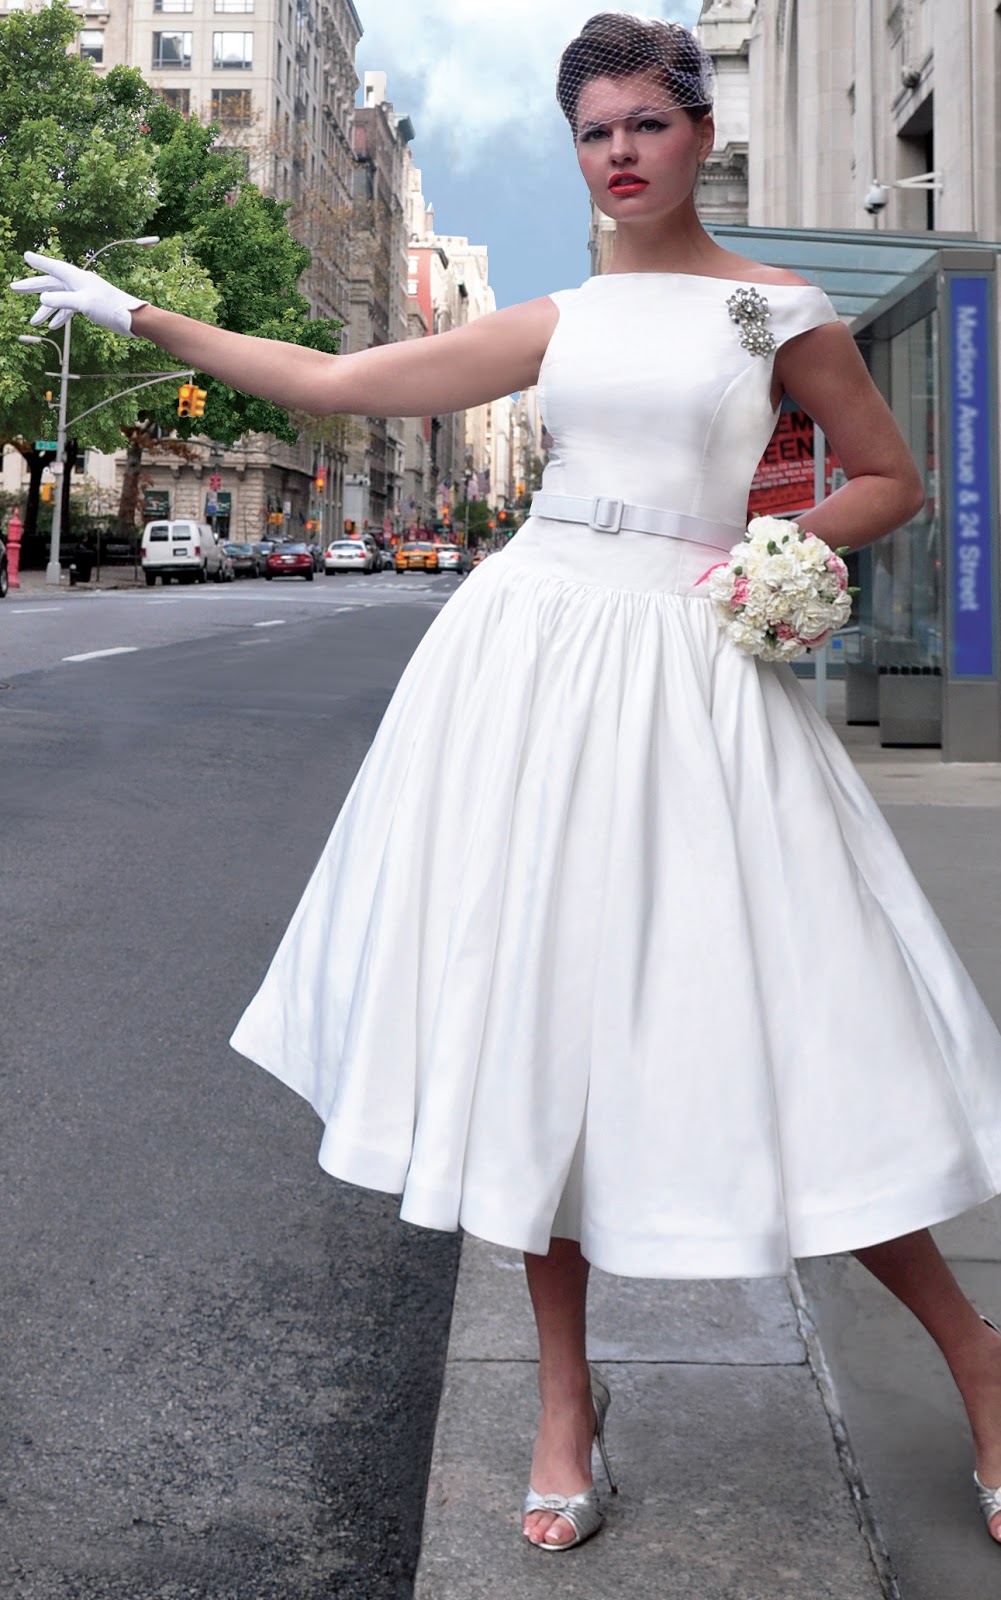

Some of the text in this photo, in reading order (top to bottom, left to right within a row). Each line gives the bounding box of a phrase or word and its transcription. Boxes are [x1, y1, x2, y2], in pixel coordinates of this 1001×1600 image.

[957, 305, 981, 612] Madison Avenue & 24 Street
